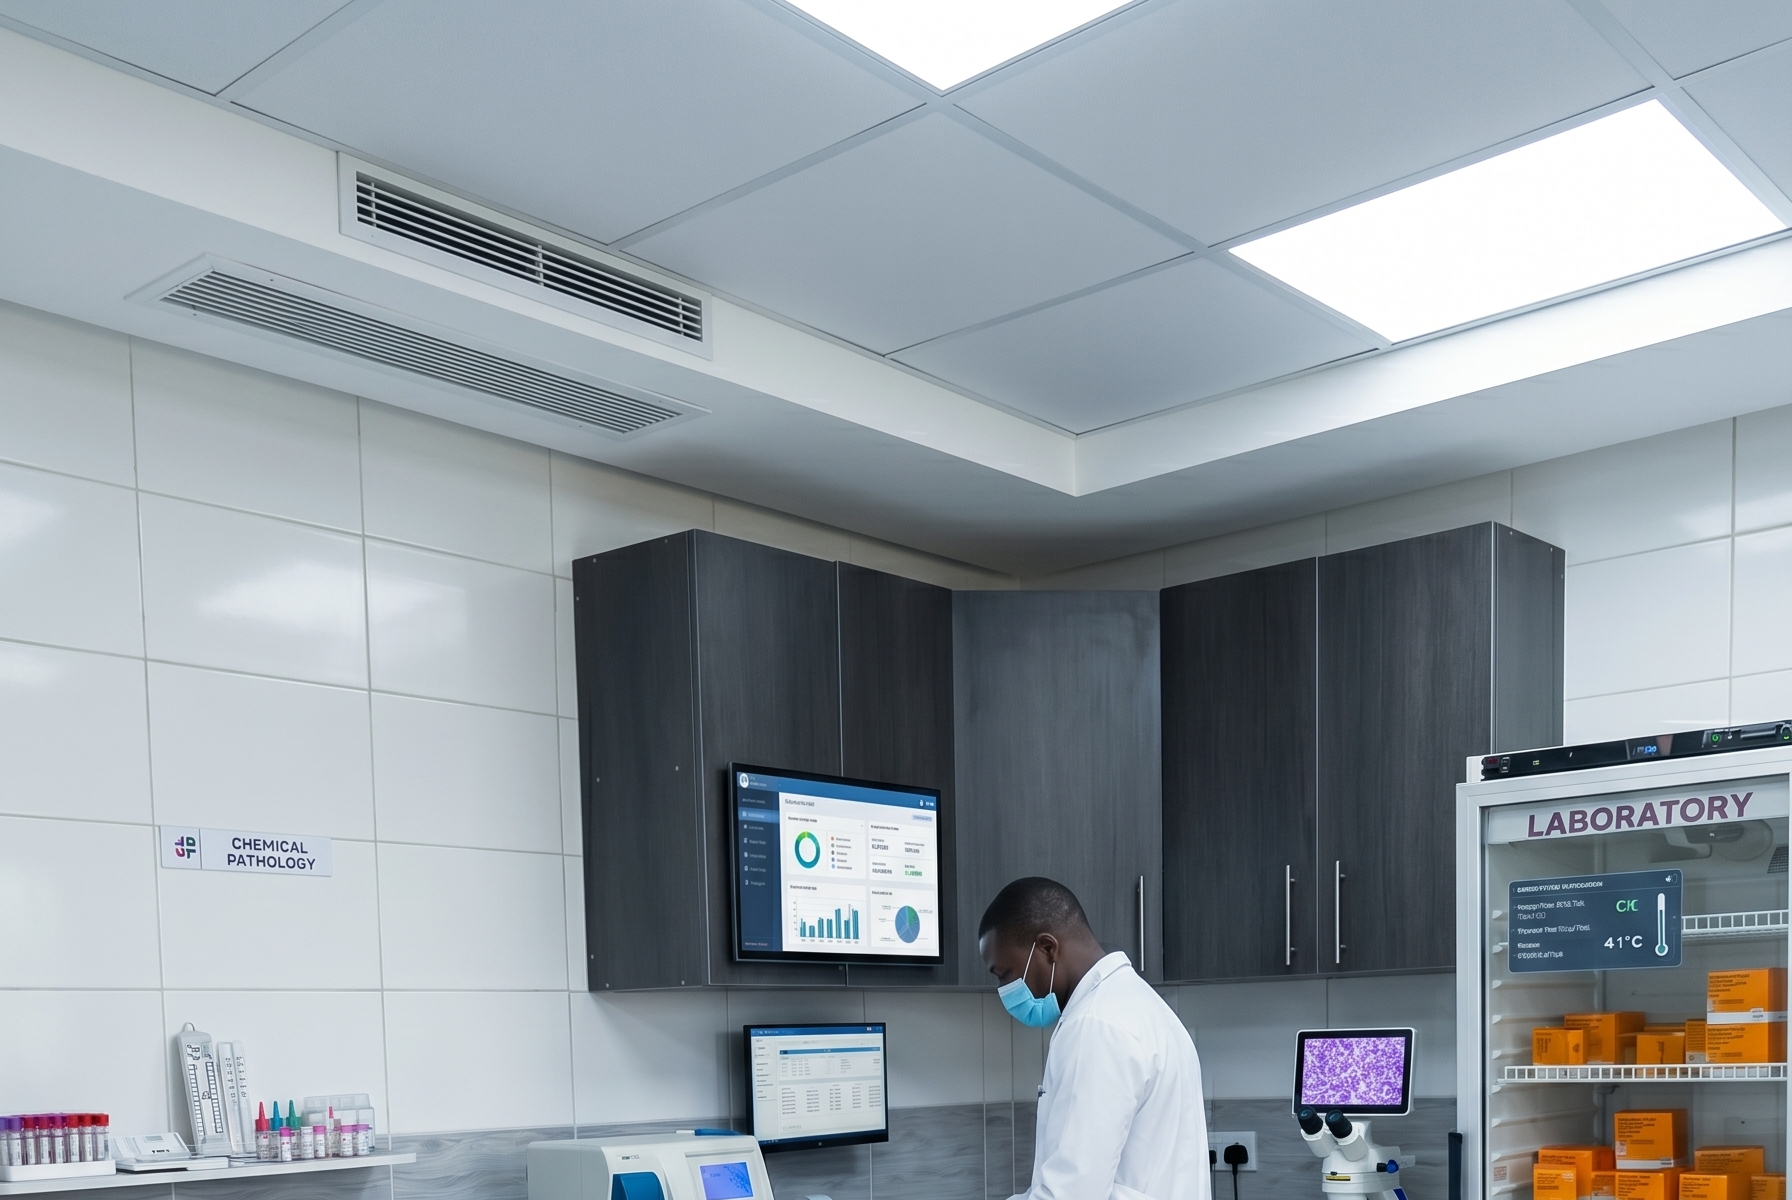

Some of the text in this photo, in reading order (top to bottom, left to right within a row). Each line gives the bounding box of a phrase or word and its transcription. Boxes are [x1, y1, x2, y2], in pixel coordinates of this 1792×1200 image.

[1527, 792, 1754, 838] LABORATORY
[231, 837, 308, 854] CHEMICAL
[227, 853, 316, 870] PATHOLOGY
